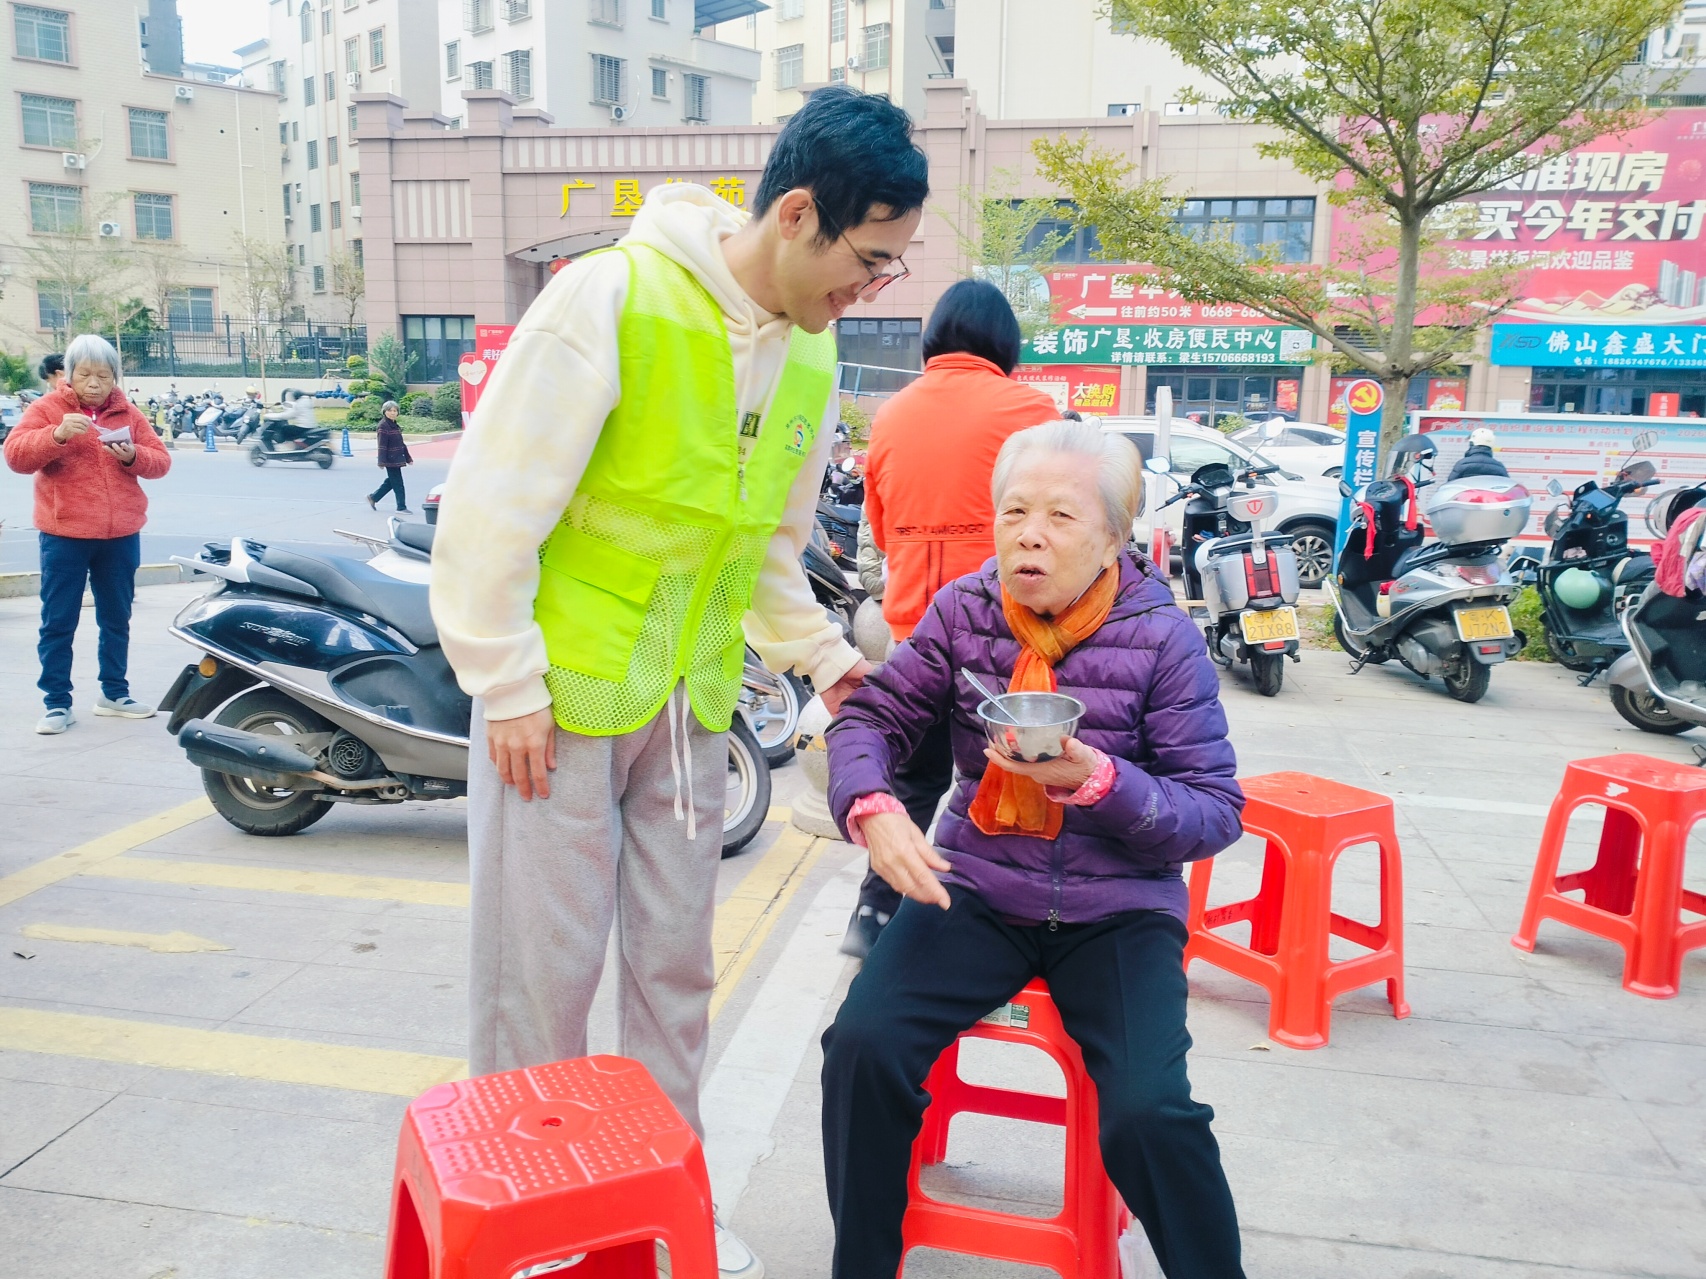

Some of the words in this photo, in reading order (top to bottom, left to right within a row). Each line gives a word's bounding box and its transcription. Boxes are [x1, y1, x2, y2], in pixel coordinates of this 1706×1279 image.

[560, 176, 747, 218] 广垦苑
[1120, 305, 1192, 318] 往前约50米
[482, 349, 507, 361] 美好
[1353, 430, 1377, 487] 宣传栏
[1249, 622, 1294, 639] 2TX88
